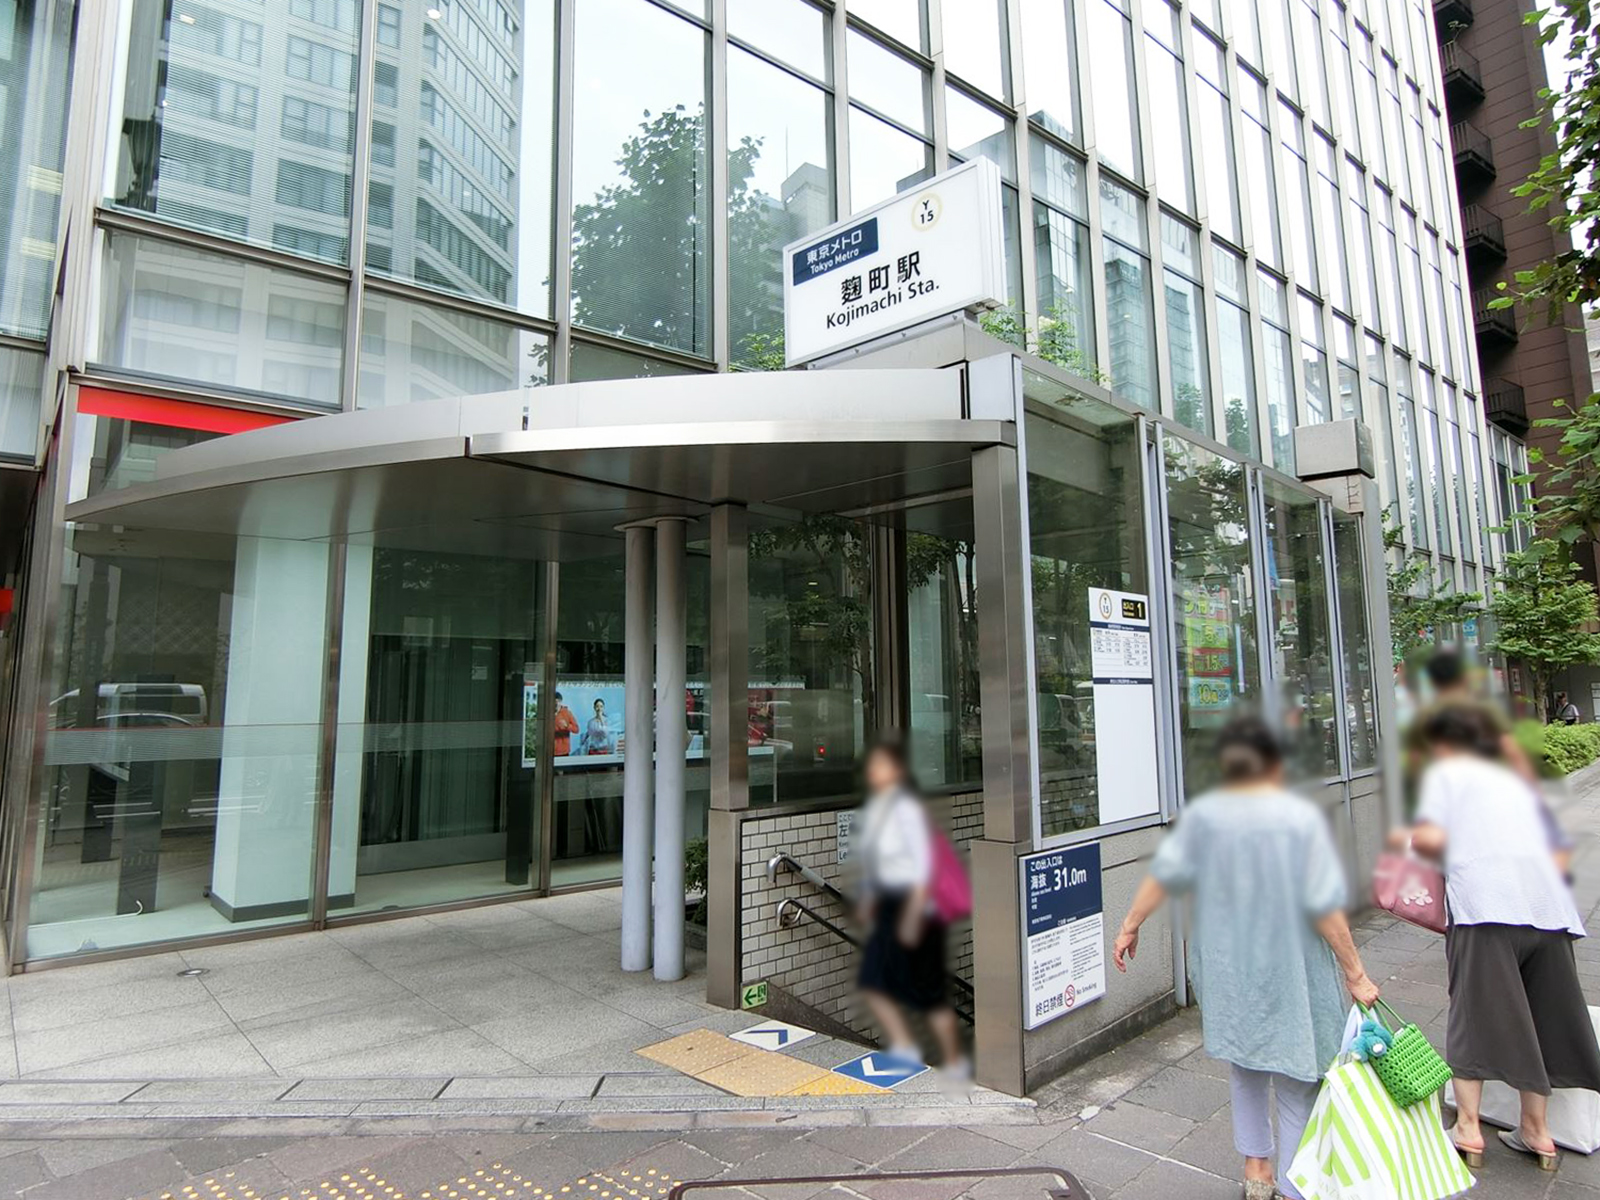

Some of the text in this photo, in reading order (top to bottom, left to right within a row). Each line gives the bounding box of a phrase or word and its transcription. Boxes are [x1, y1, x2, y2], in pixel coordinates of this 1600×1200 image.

[922, 199, 930, 210] Y
[920, 210, 935, 224] 15
[806, 229, 862, 265] 東京メトロ
[810, 247, 859, 274] Tokyo Metro
[826, 279, 940, 329] Kojimachi Sta.
[1137, 602, 1142, 618] 1
[1053, 867, 1087, 891] 31.0m
